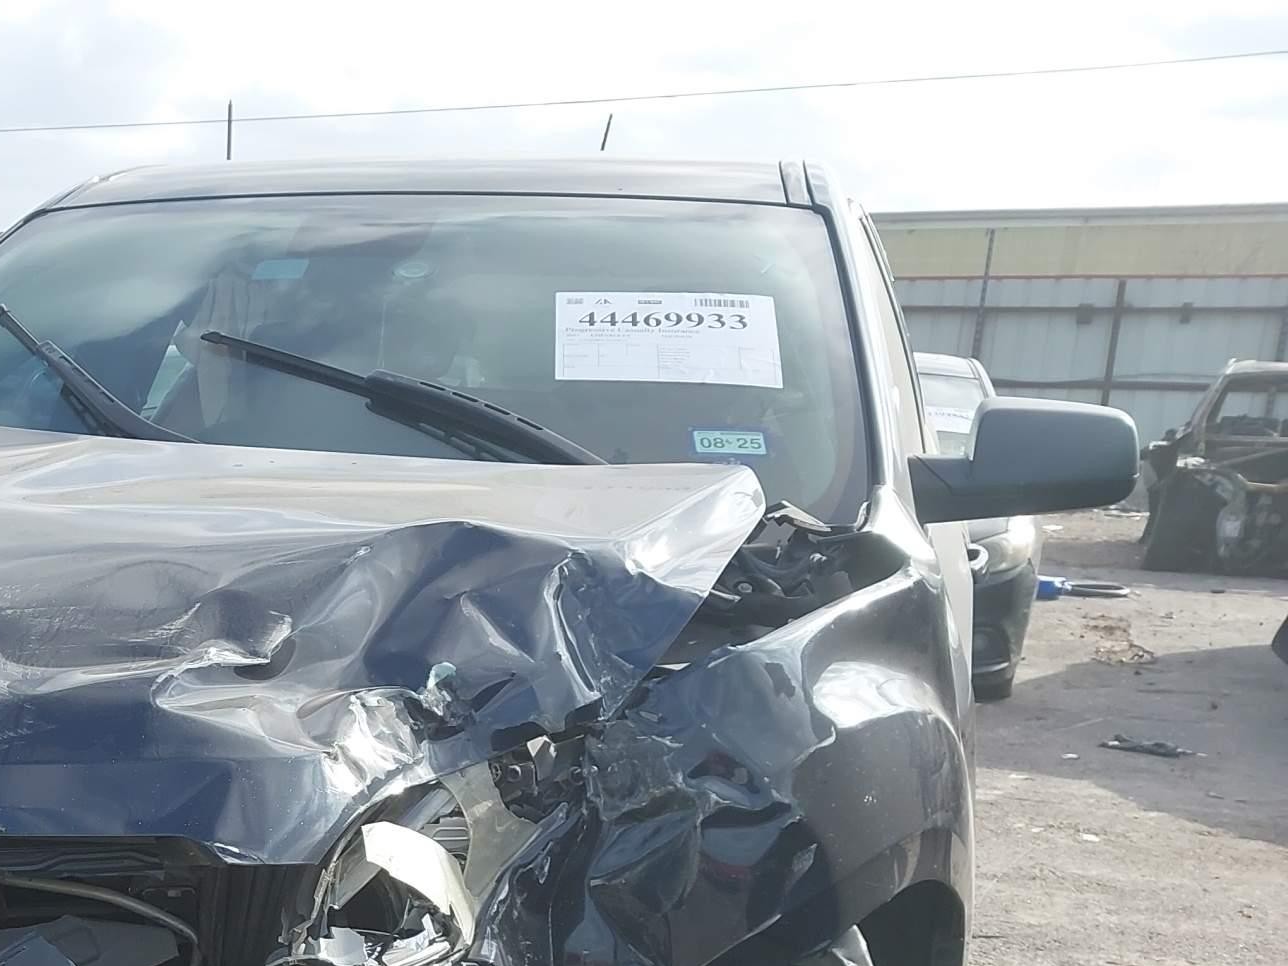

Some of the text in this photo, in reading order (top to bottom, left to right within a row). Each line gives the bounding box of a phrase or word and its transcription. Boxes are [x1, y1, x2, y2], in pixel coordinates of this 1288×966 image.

[578, 311, 748, 330] 44469933
[700, 437, 762, 450] 08 25
